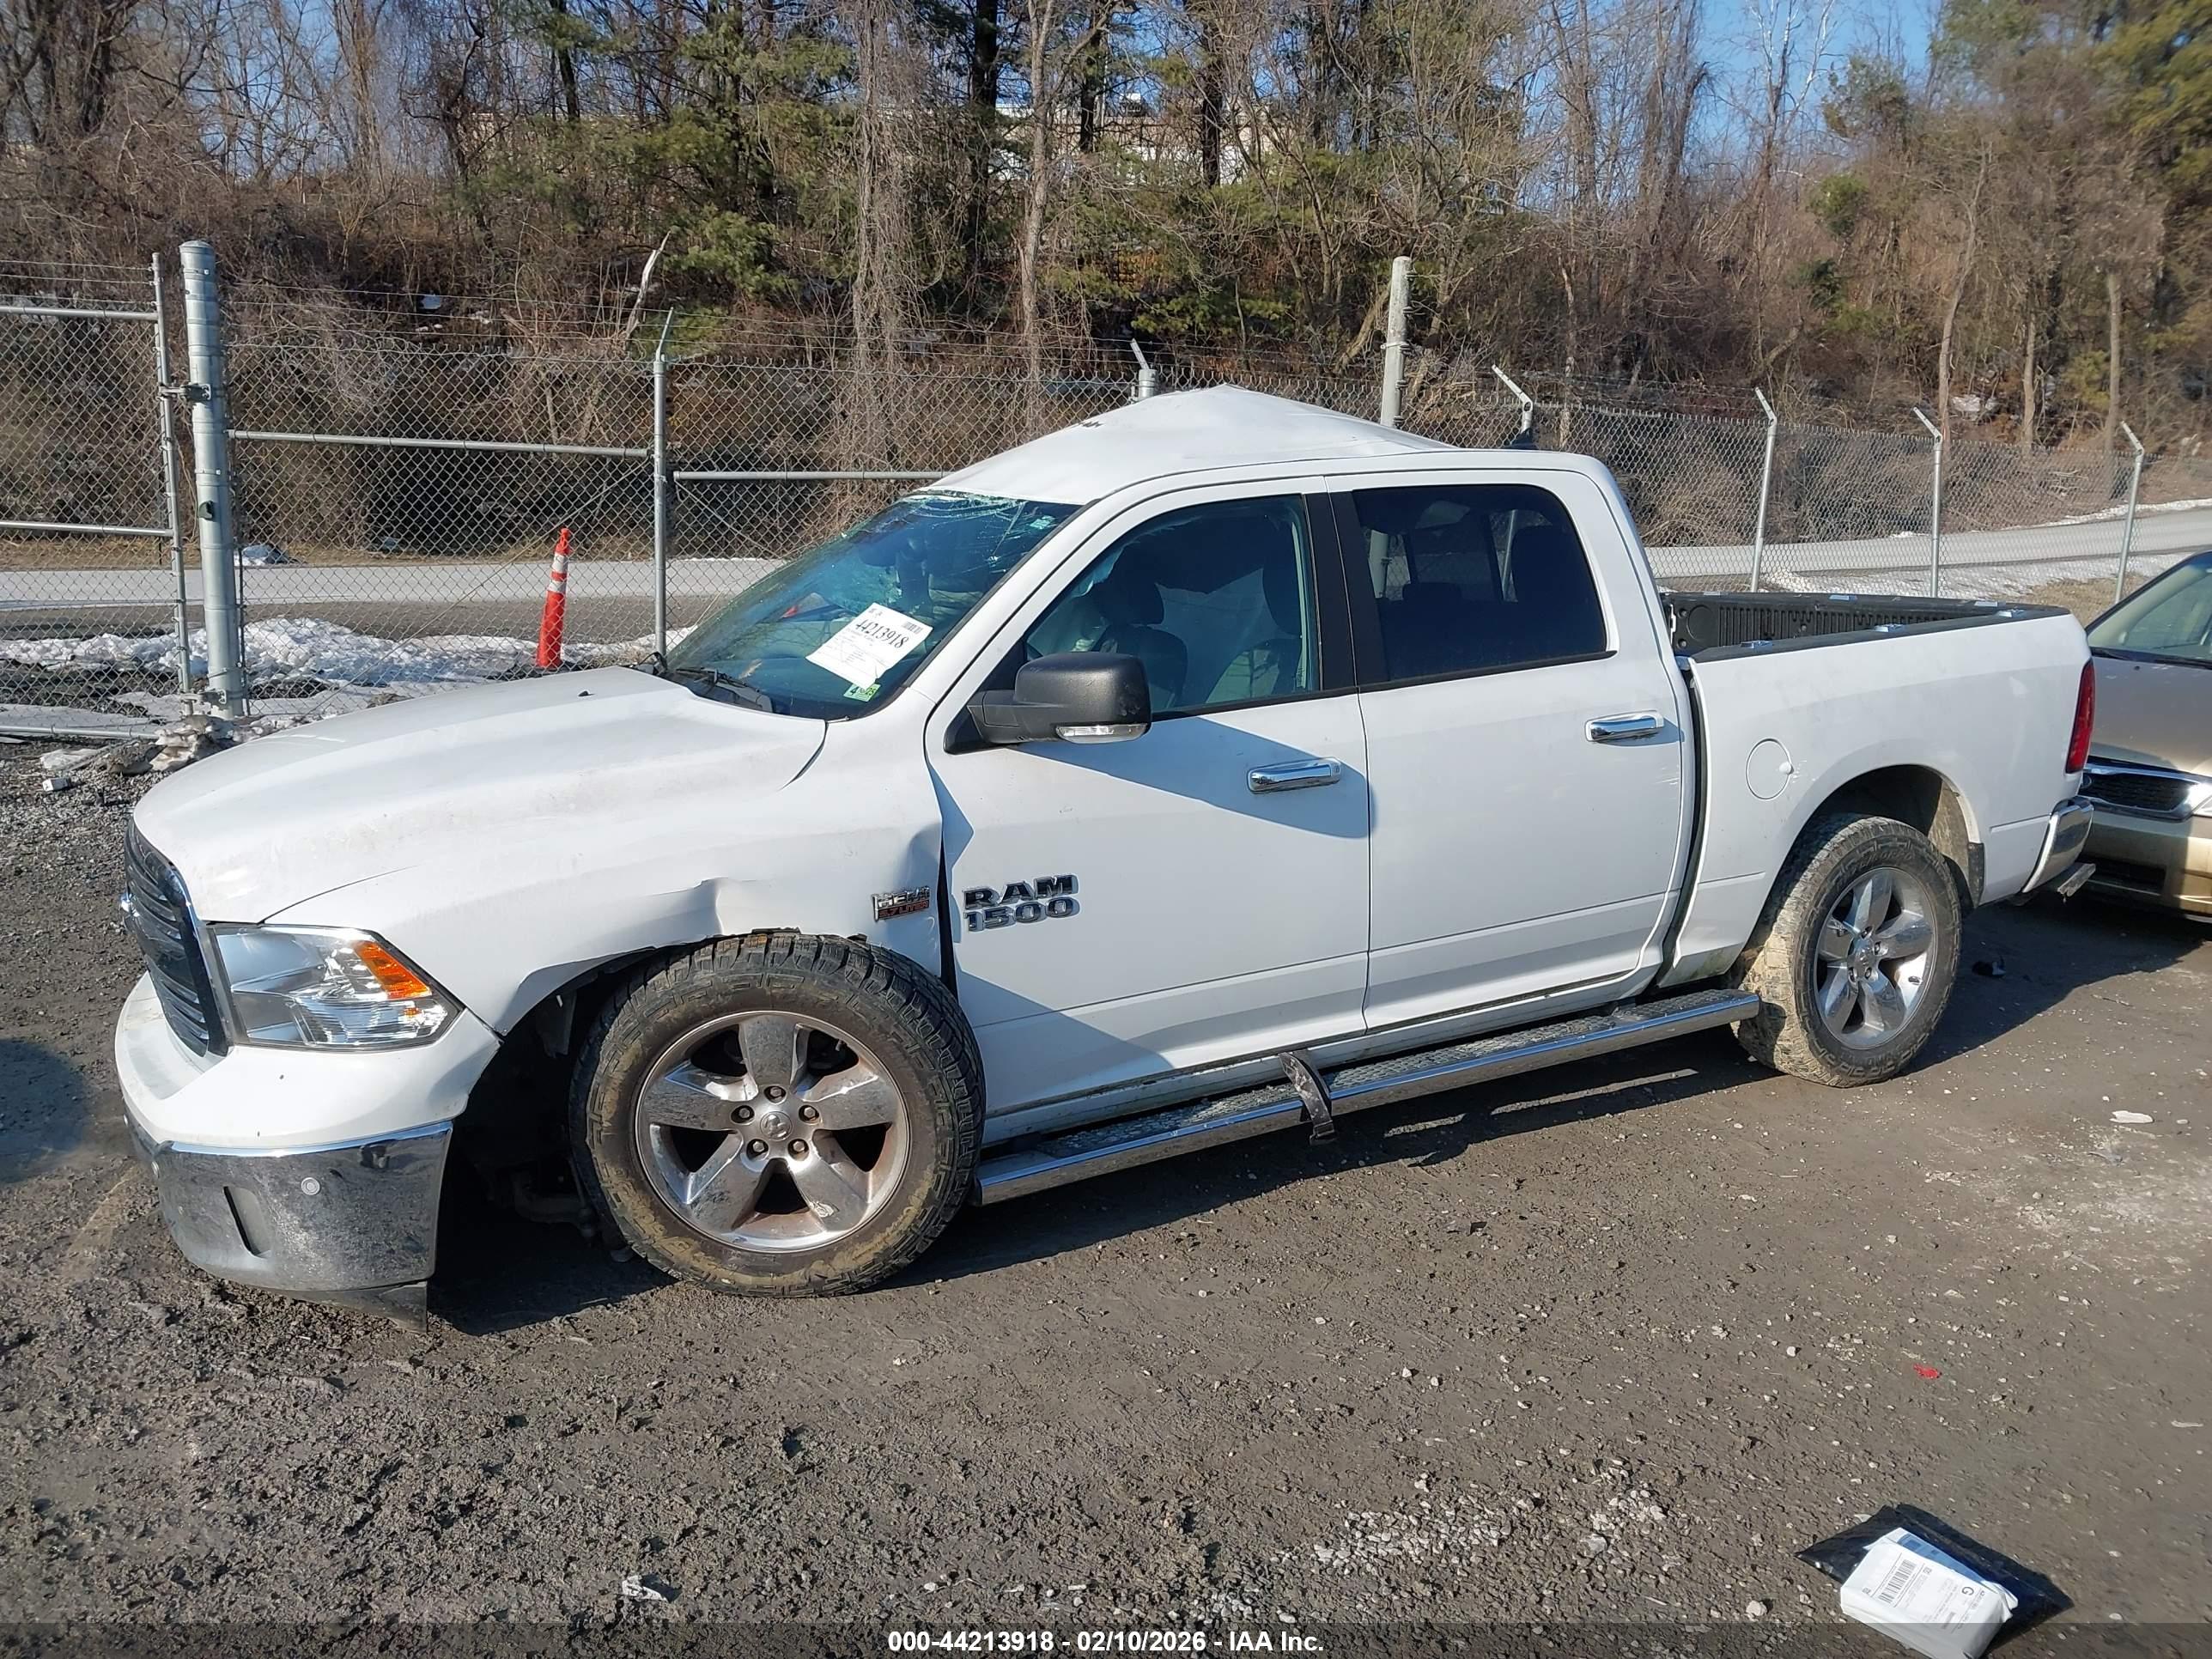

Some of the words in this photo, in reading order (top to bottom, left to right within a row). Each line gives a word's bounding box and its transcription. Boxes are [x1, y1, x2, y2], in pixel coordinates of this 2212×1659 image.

[855, 619, 909, 648] 44213918
[962, 873, 1079, 910] RAM
[963, 896, 1080, 932] 1500
